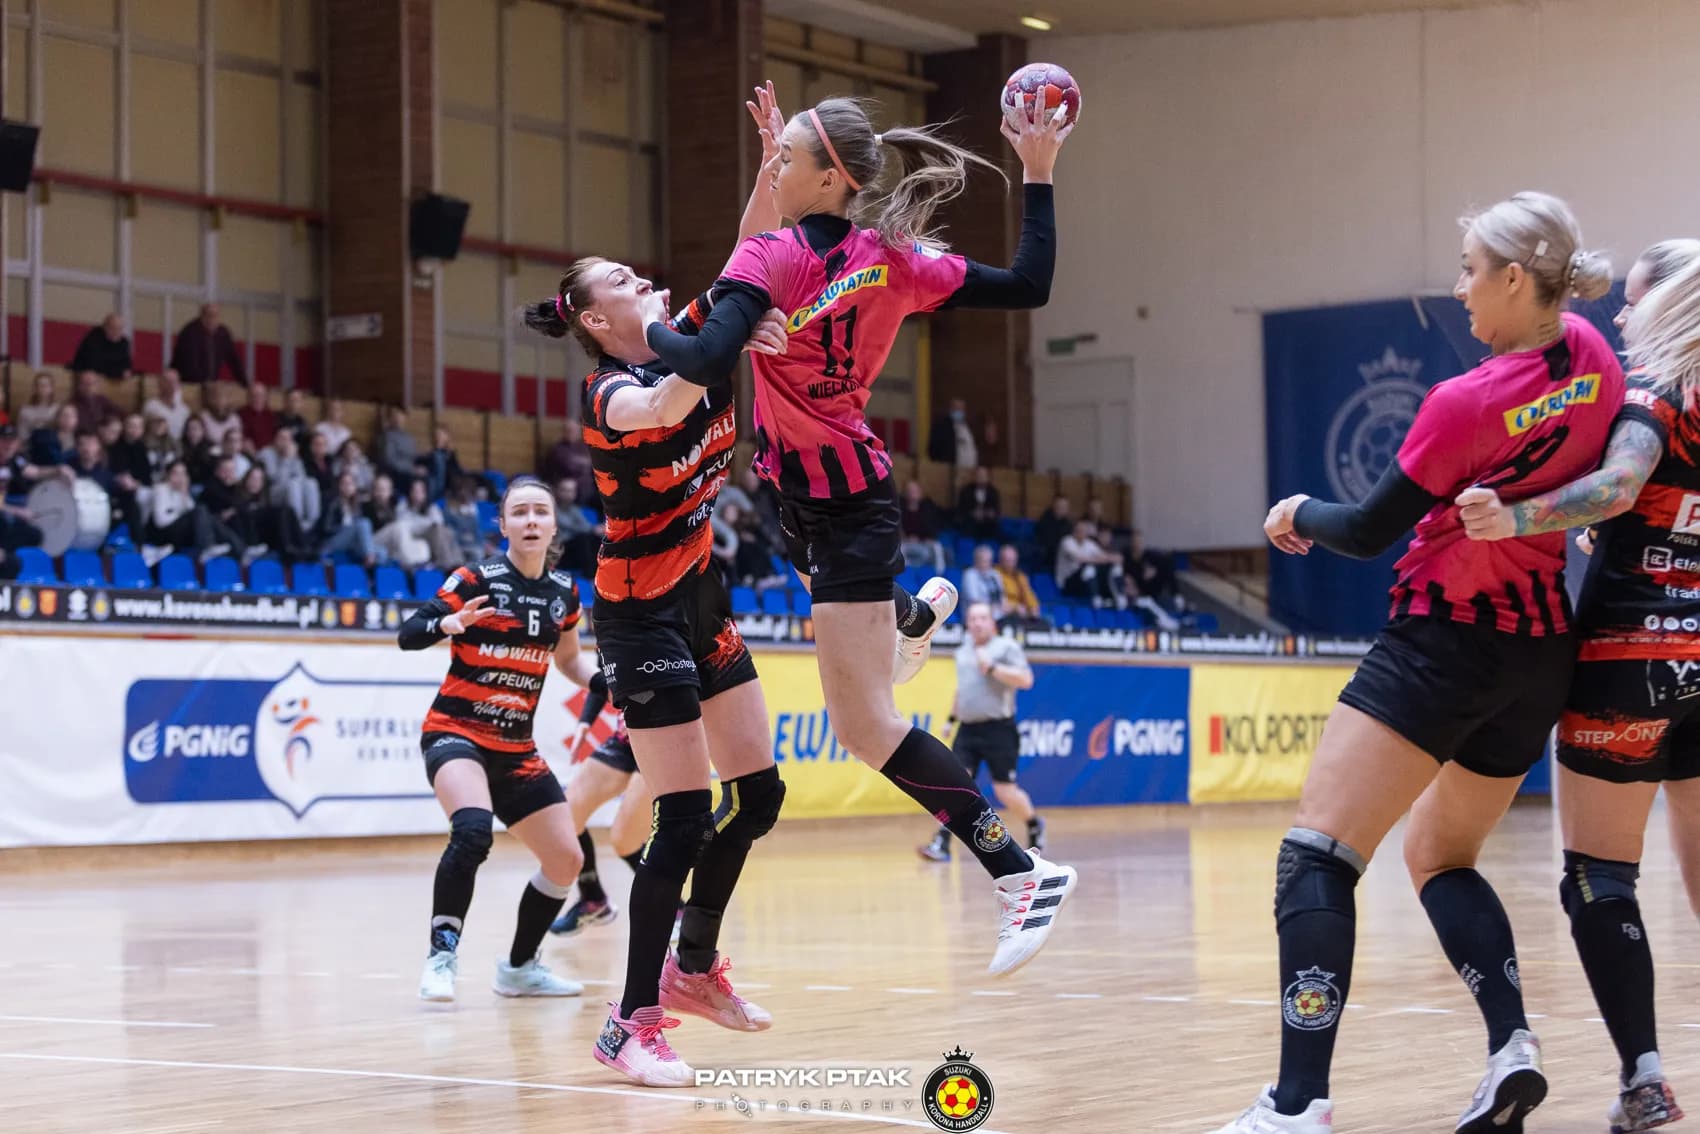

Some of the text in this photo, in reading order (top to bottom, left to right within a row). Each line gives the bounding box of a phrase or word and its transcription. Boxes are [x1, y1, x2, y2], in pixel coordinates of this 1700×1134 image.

[819, 305, 858, 379] 11
[528, 609, 540, 636] 6
[164, 724, 250, 758] PGNiG
[1018, 719, 1075, 757] GNiG
[1114, 718, 1186, 756] PGNiG
[1222, 714, 1331, 754] KOLPORT
[1574, 730, 1616, 743] STEP
